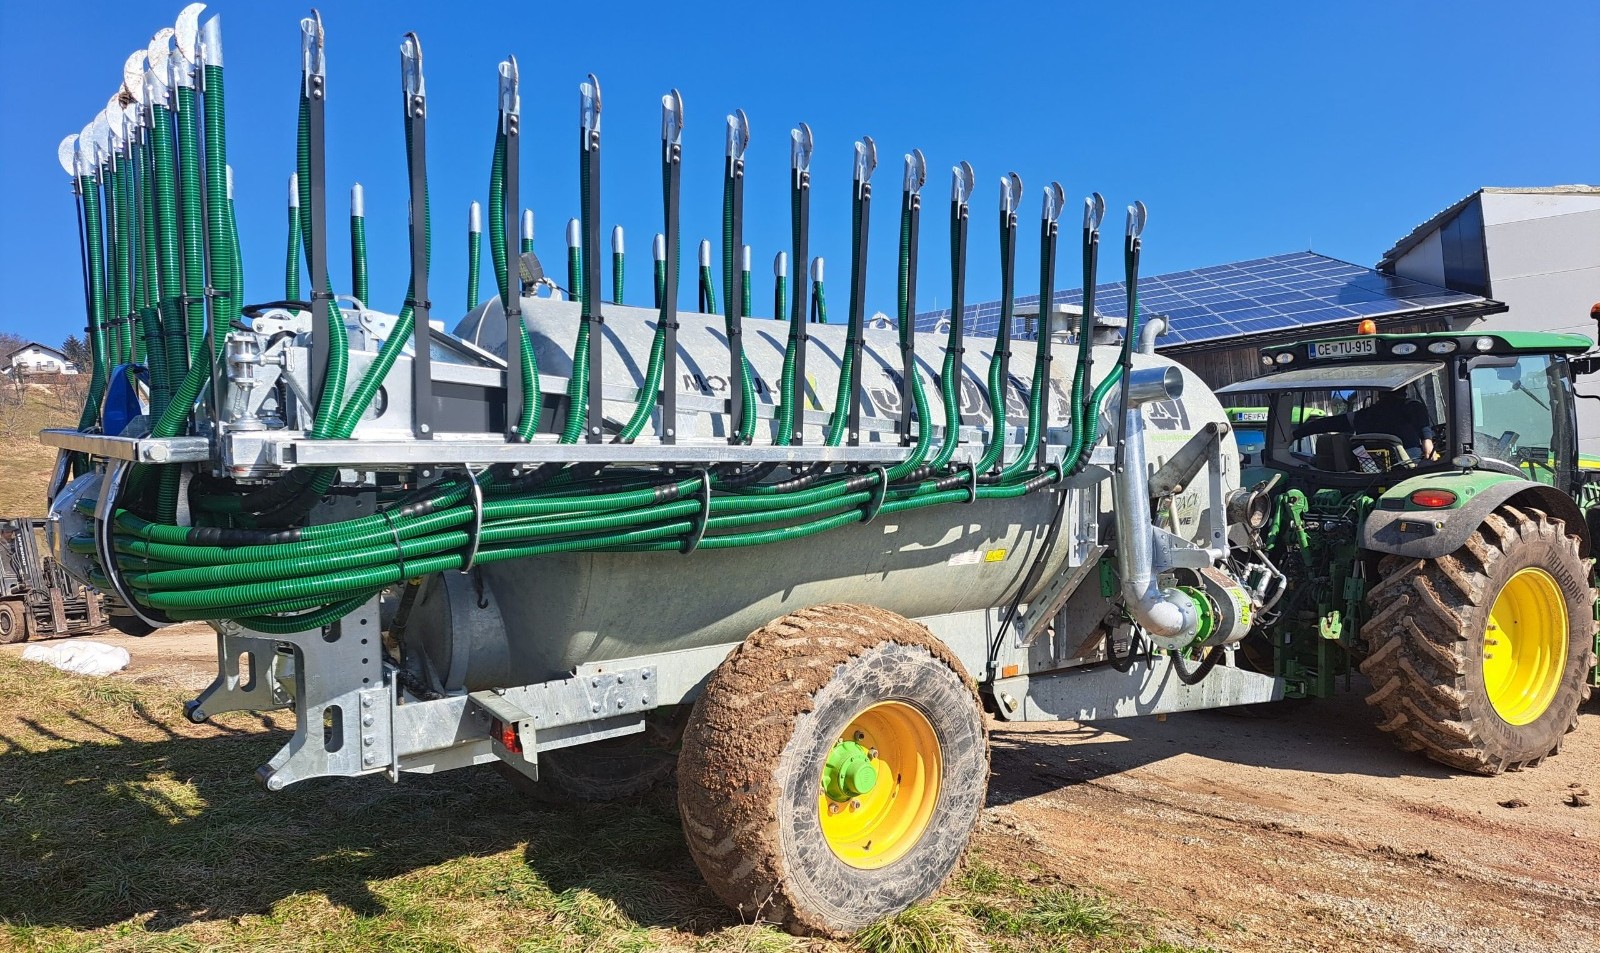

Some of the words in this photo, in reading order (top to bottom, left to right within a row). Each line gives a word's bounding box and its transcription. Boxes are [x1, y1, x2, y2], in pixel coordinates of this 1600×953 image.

[1318, 344, 1331, 355] CE
[1339, 340, 1372, 354] TU-915
[1544, 545, 1585, 605] TRELLEBORG
